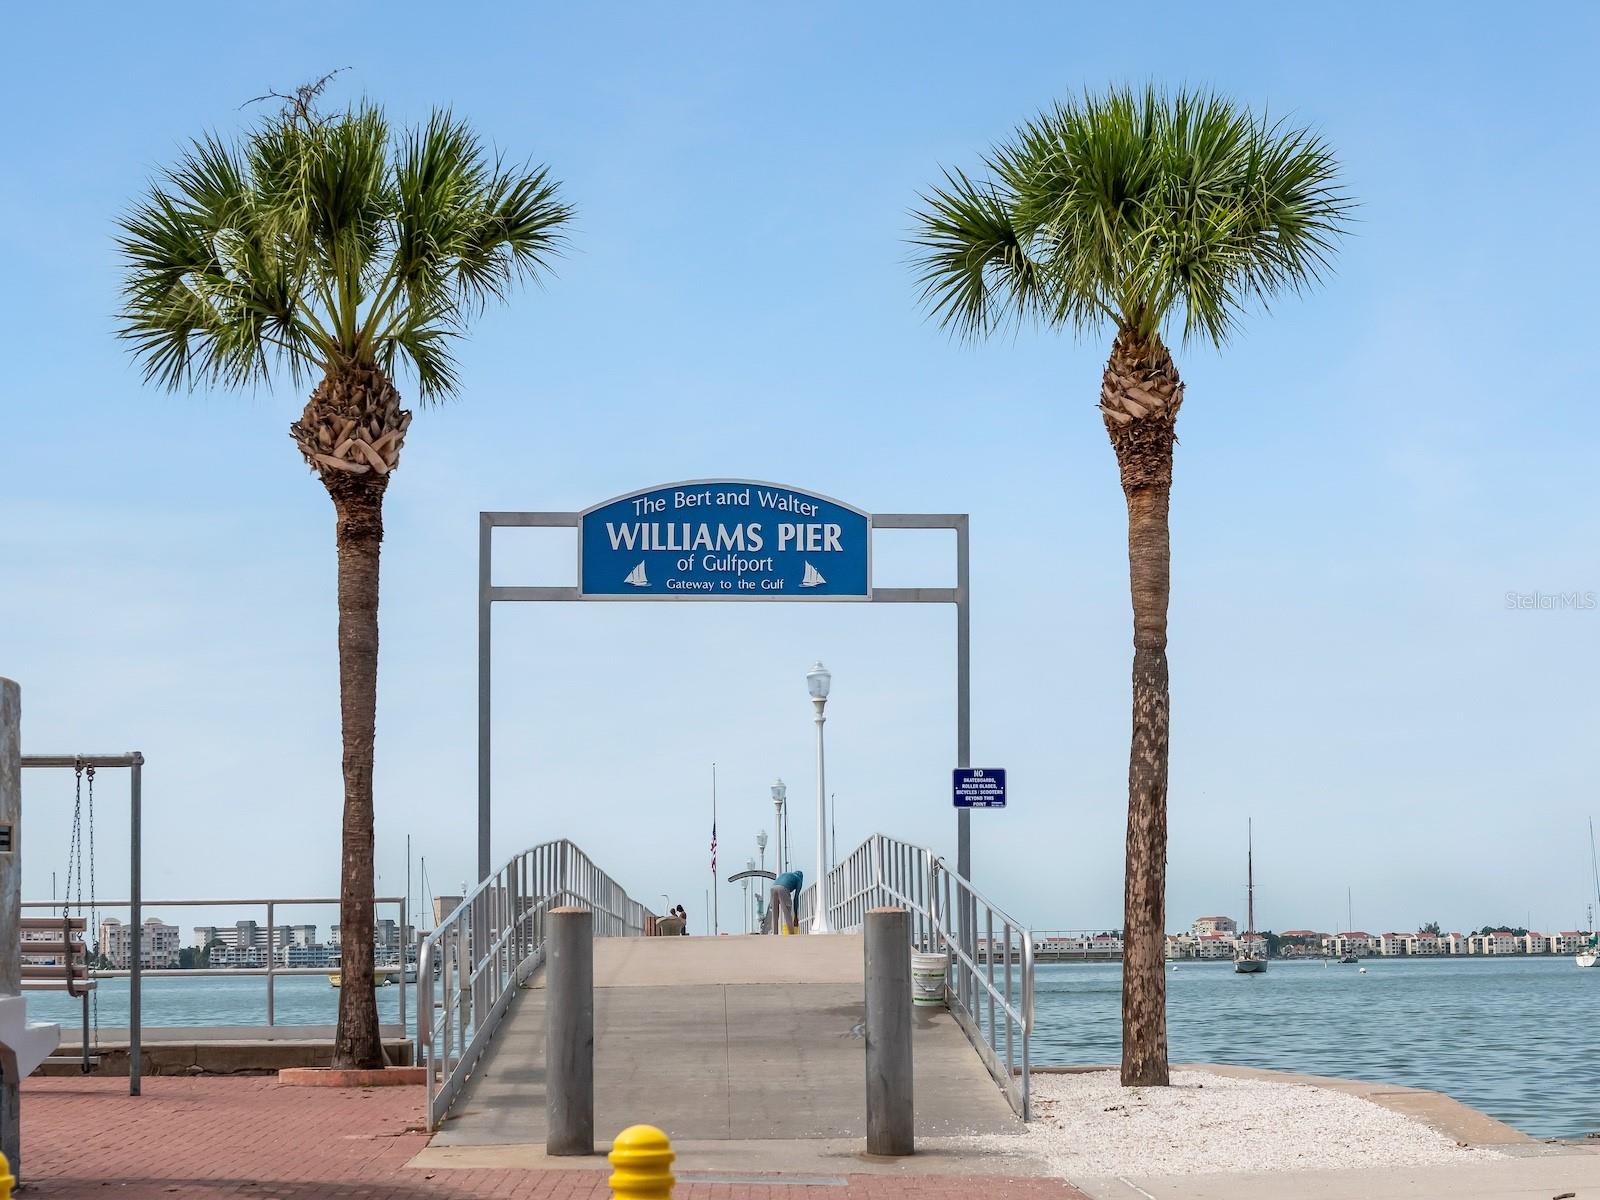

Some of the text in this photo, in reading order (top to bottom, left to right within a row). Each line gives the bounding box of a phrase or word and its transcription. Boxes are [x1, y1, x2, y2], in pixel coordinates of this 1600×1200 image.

[632, 488, 819, 517] The Bert and Walter
[605, 522, 843, 552] WILLIAMS PIER
[677, 553, 773, 577] of Gulfport
[666, 578, 785, 591] Gateway to the Gulf
